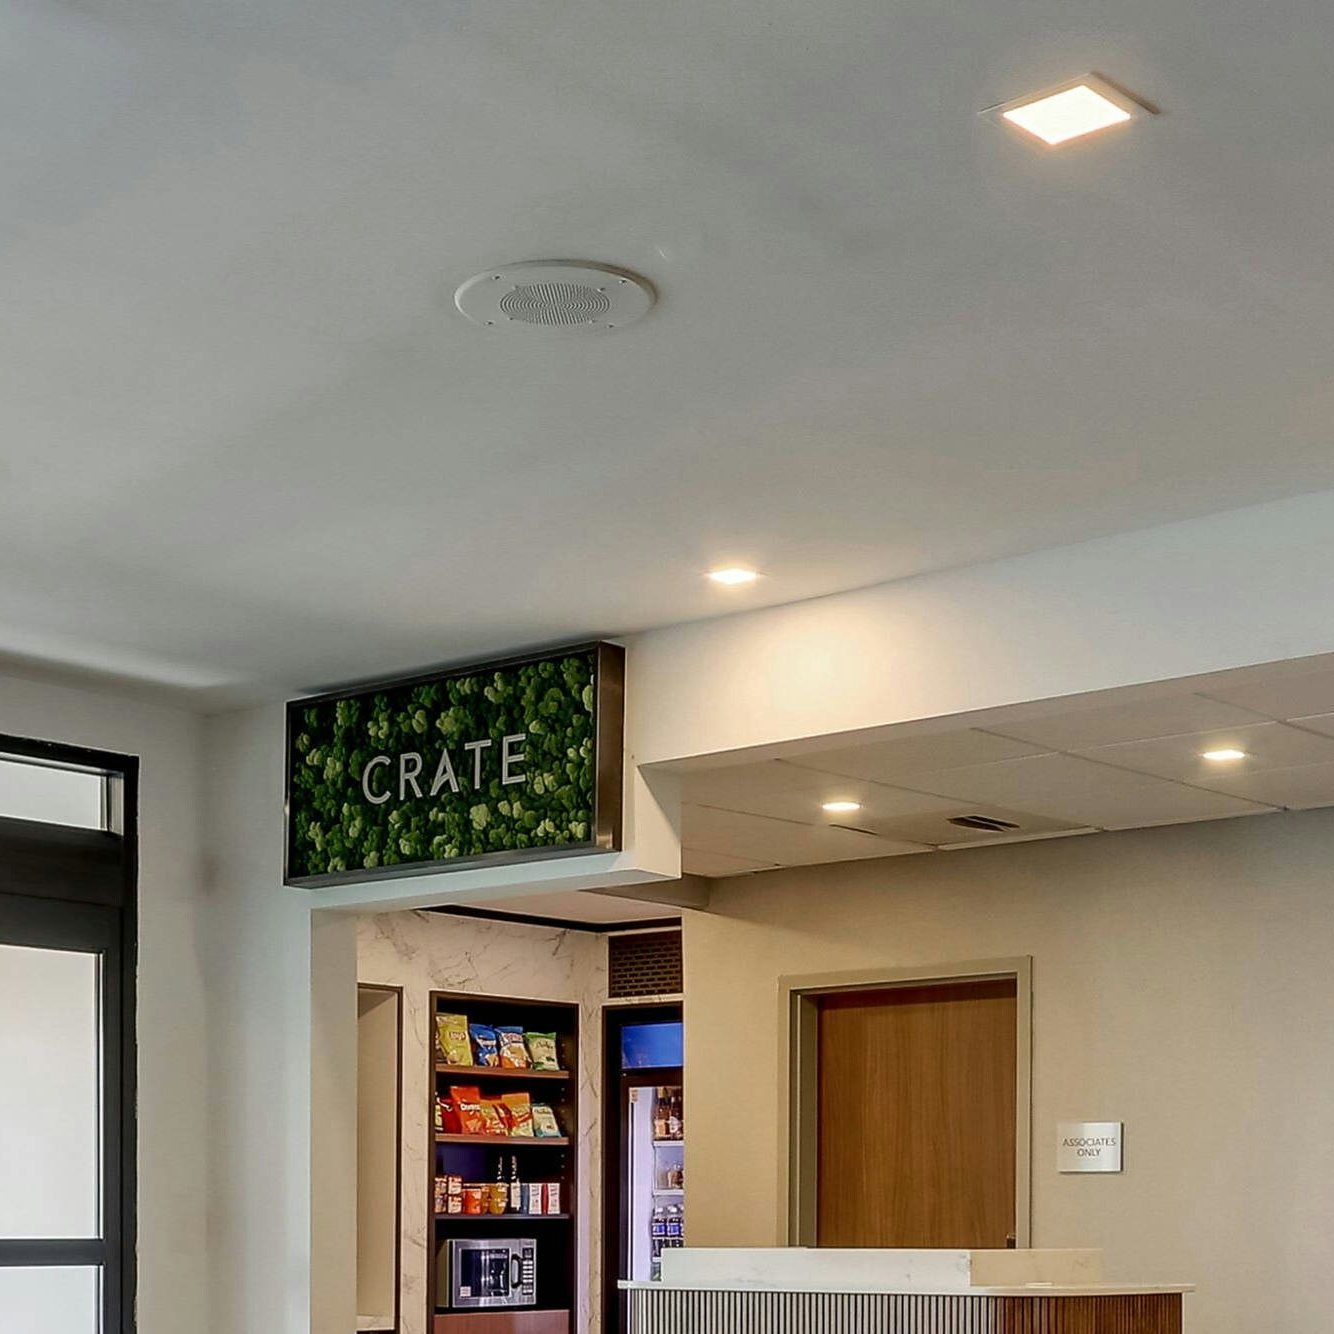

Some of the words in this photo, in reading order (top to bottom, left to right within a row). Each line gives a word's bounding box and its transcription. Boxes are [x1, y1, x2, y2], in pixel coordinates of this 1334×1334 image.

[362, 733, 527, 804] CRATE
[1063, 1138, 1116, 1147] ASSOCIATES
[1077, 1149, 1101, 1157] ONLY
